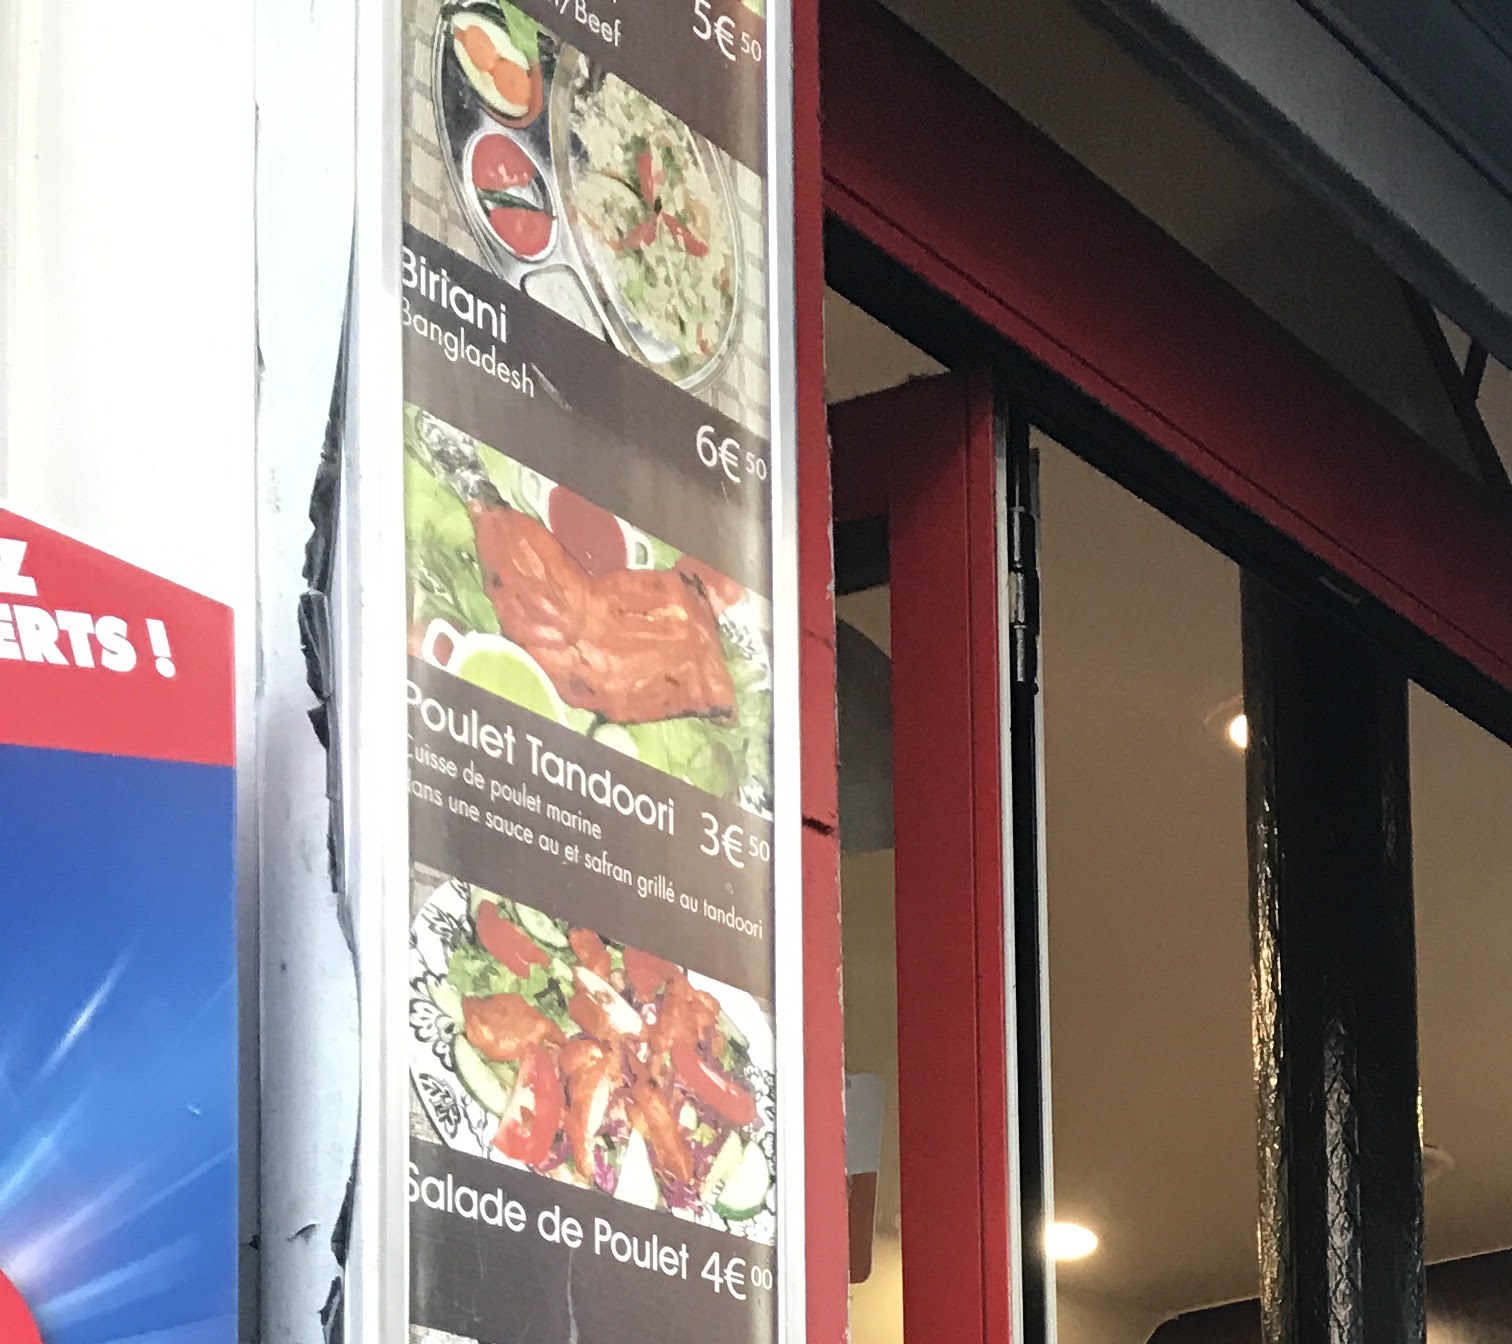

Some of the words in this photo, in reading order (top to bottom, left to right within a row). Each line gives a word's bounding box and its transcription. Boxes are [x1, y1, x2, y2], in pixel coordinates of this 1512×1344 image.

[402, 245, 507, 343] Biriani
[402, 296, 534, 398] Bangladesh
[407, 679, 516, 765] Poulet
[525, 734, 675, 835] Tandoori
[462, 760, 486, 790] de
[490, 778, 542, 814] poulet
[547, 803, 602, 840] marine
[448, 795, 481, 823] une
[485, 811, 534, 845] sauce
[538, 835, 560, 860] au
[563, 844, 580, 864] et
[584, 851, 633, 886] safran
[637, 874, 675, 903] grillé
[679, 893, 698, 912] au
[703, 899, 763, 940] tandoori
[408, 1161, 527, 1232] Salade
[537, 1205, 584, 1248] de
[594, 1217, 689, 1280] Poulet
